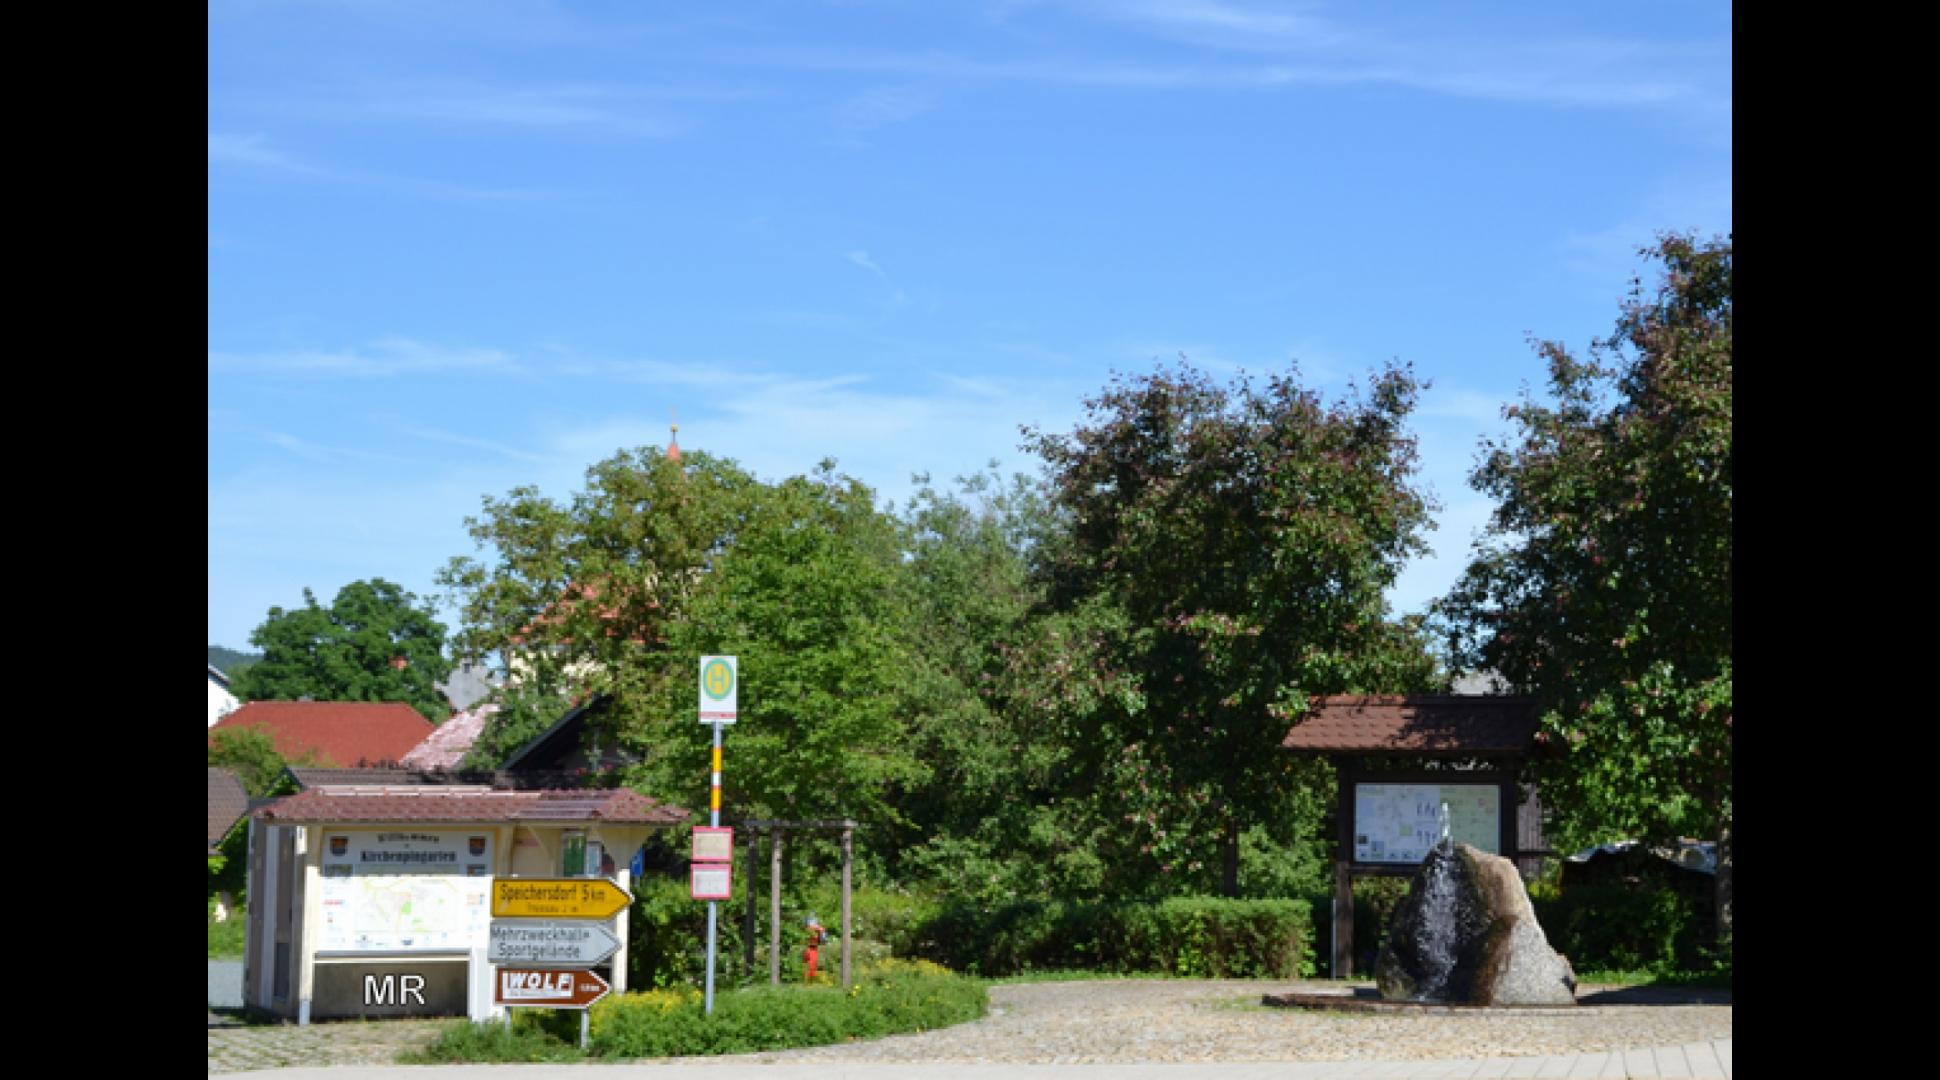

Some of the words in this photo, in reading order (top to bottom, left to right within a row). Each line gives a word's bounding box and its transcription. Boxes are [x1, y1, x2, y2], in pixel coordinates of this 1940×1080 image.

[500, 883, 577, 902] Speichersdorf
[582, 883, 589, 902] 5
[507, 971, 573, 990] WOLF
